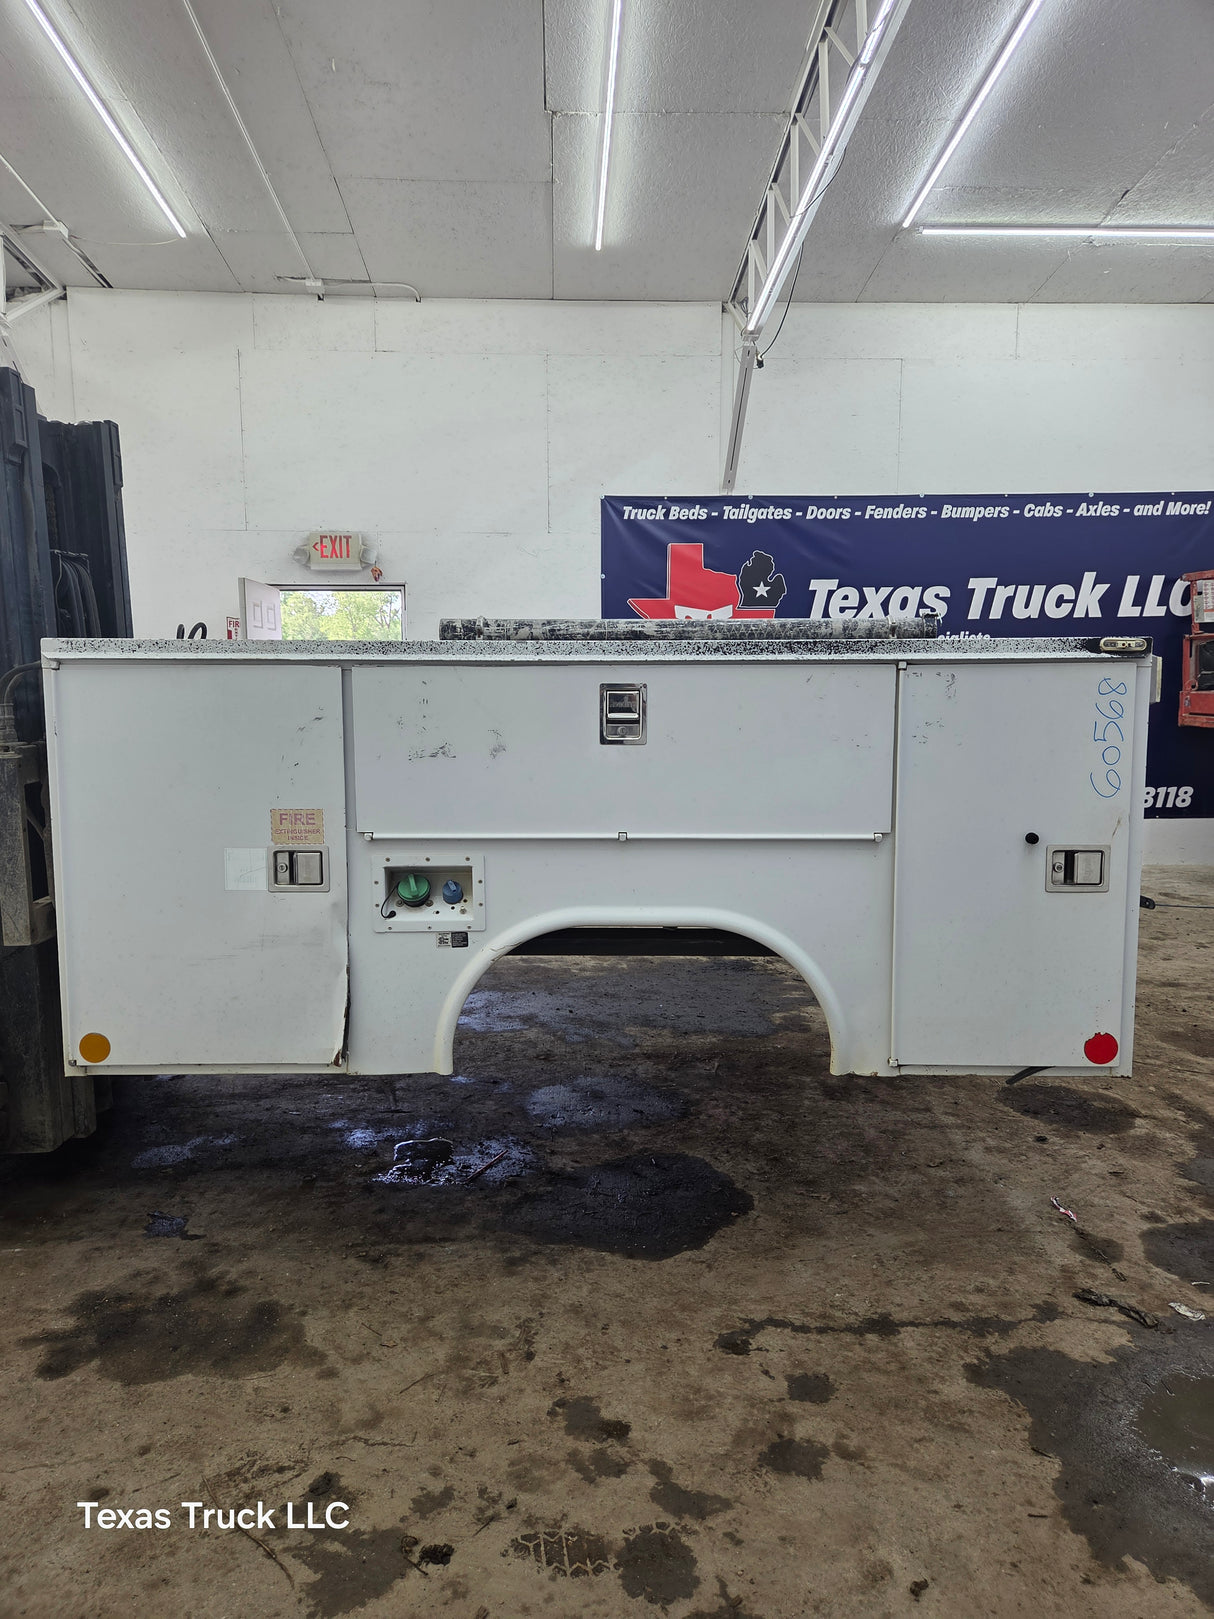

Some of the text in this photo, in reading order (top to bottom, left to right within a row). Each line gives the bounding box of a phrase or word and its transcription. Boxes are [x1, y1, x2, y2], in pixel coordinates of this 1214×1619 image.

[622, 505, 665, 520] Truck
[668, 505, 708, 520] Beds
[722, 505, 792, 523] Tailgates
[806, 505, 851, 520] Doors
[865, 504, 927, 519] Fenders
[941, 504, 1010, 521] Bumpers
[1023, 502, 1063, 518] Cabs
[1075, 501, 1120, 517] Axles
[1133, 501, 1162, 516] and
[1166, 500, 1212, 515] More!
[319, 534, 352, 559] EXIT
[808, 578, 951, 619] Texas
[967, 571, 1112, 620] Truck
[1116, 574, 1192, 618] LLC
[228, 620, 240, 628] FIR
[1089, 677, 1128, 799] 60568
[279, 812, 316, 826] FIRE
